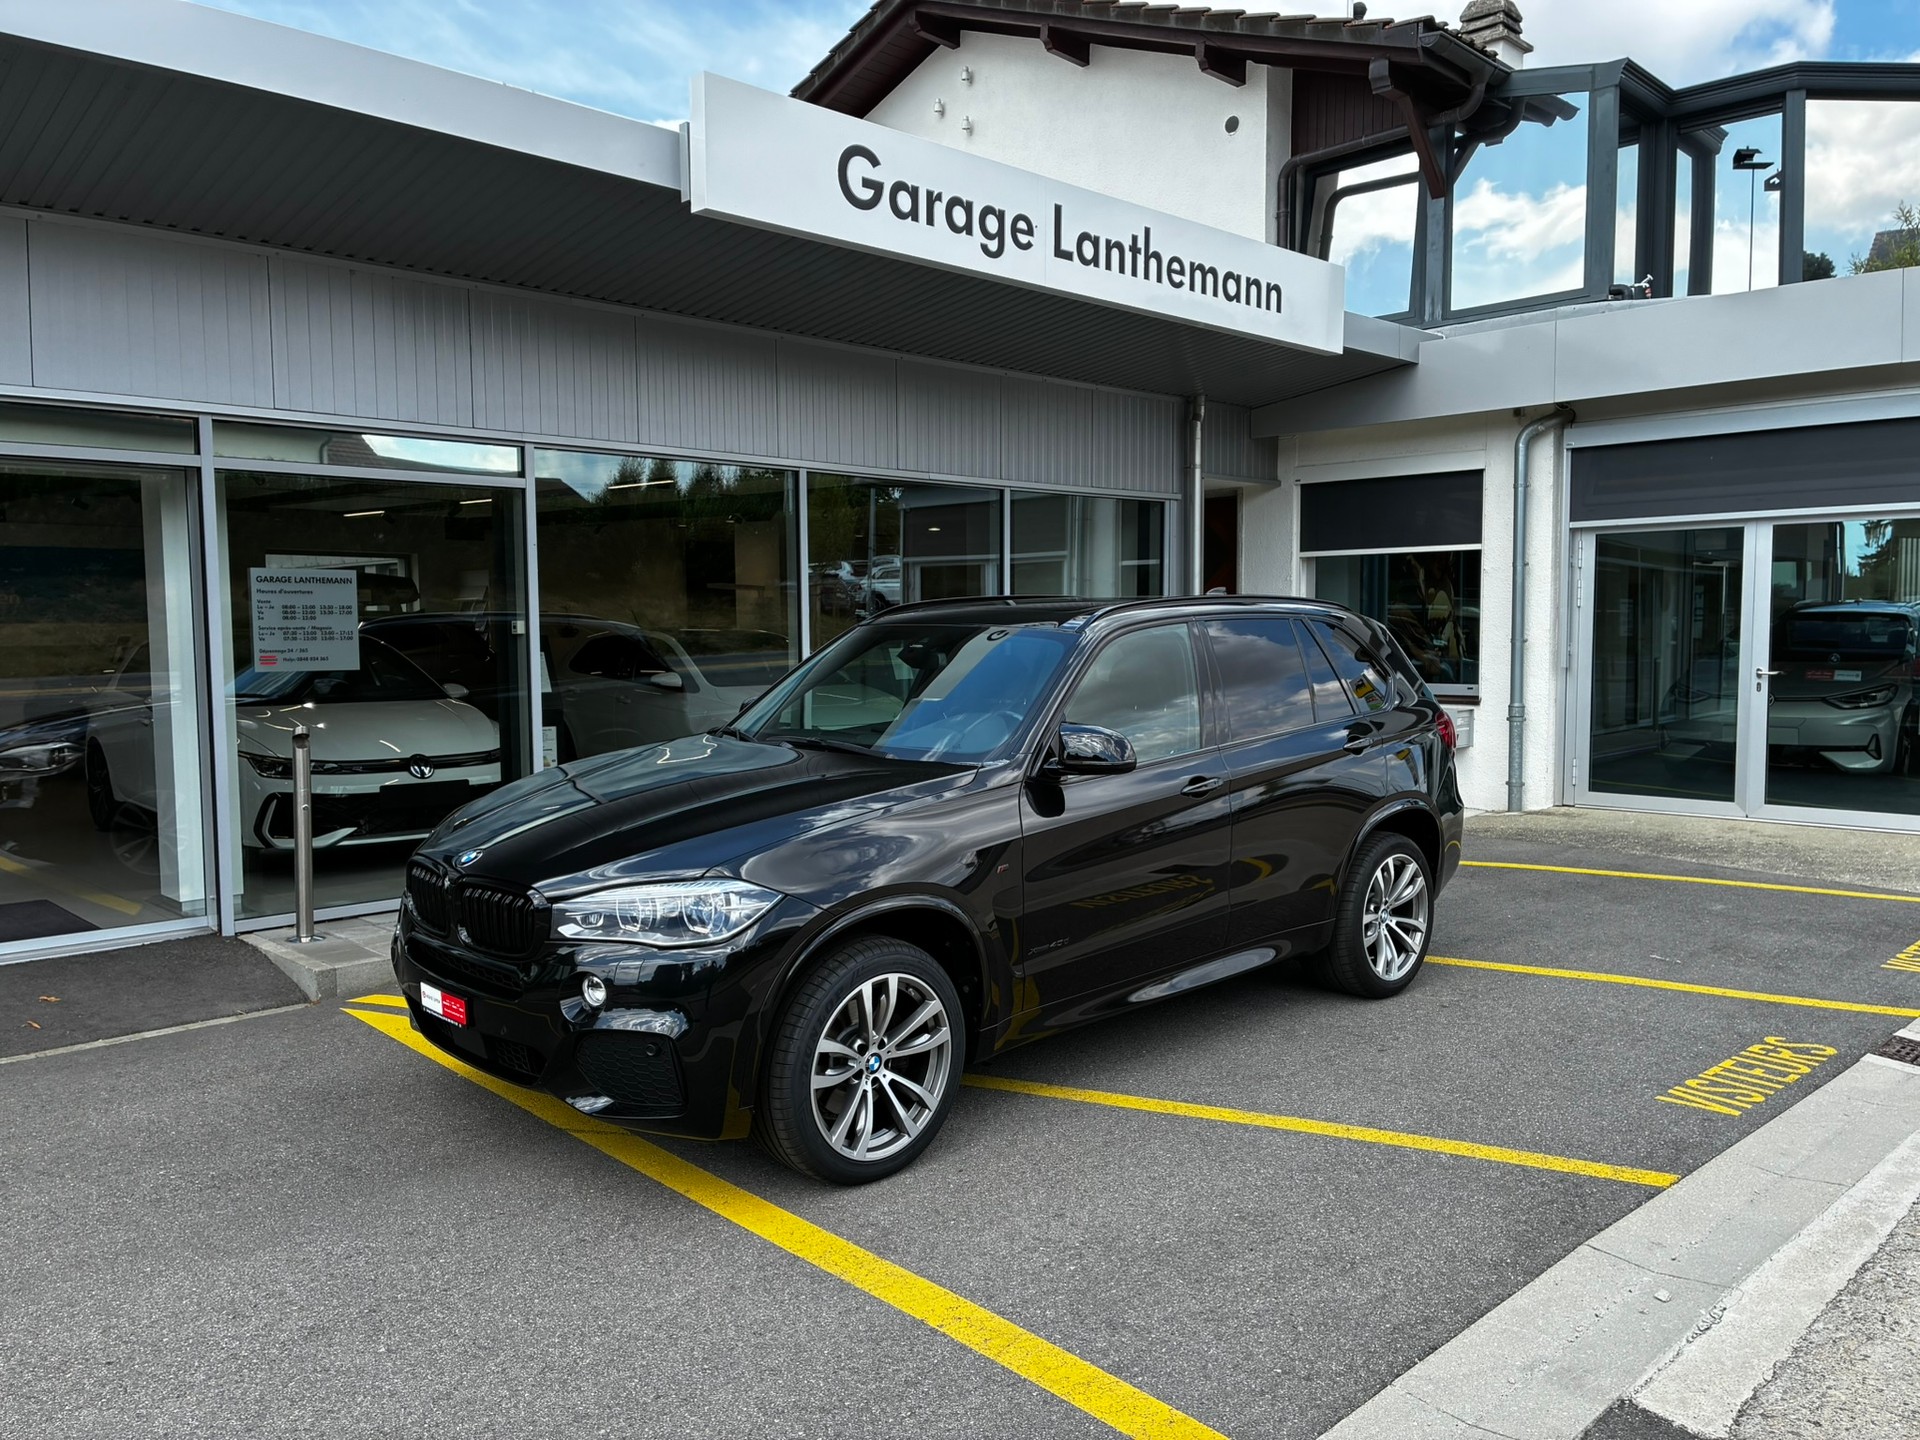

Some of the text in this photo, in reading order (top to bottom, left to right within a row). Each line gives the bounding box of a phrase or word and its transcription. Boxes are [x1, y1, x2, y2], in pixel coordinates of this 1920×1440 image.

[836, 143, 1284, 314] Garage Lanthemann
[256, 575, 352, 584] GARAGE LANTHEMANN
[1654, 1036, 1838, 1117] VISITEURS
